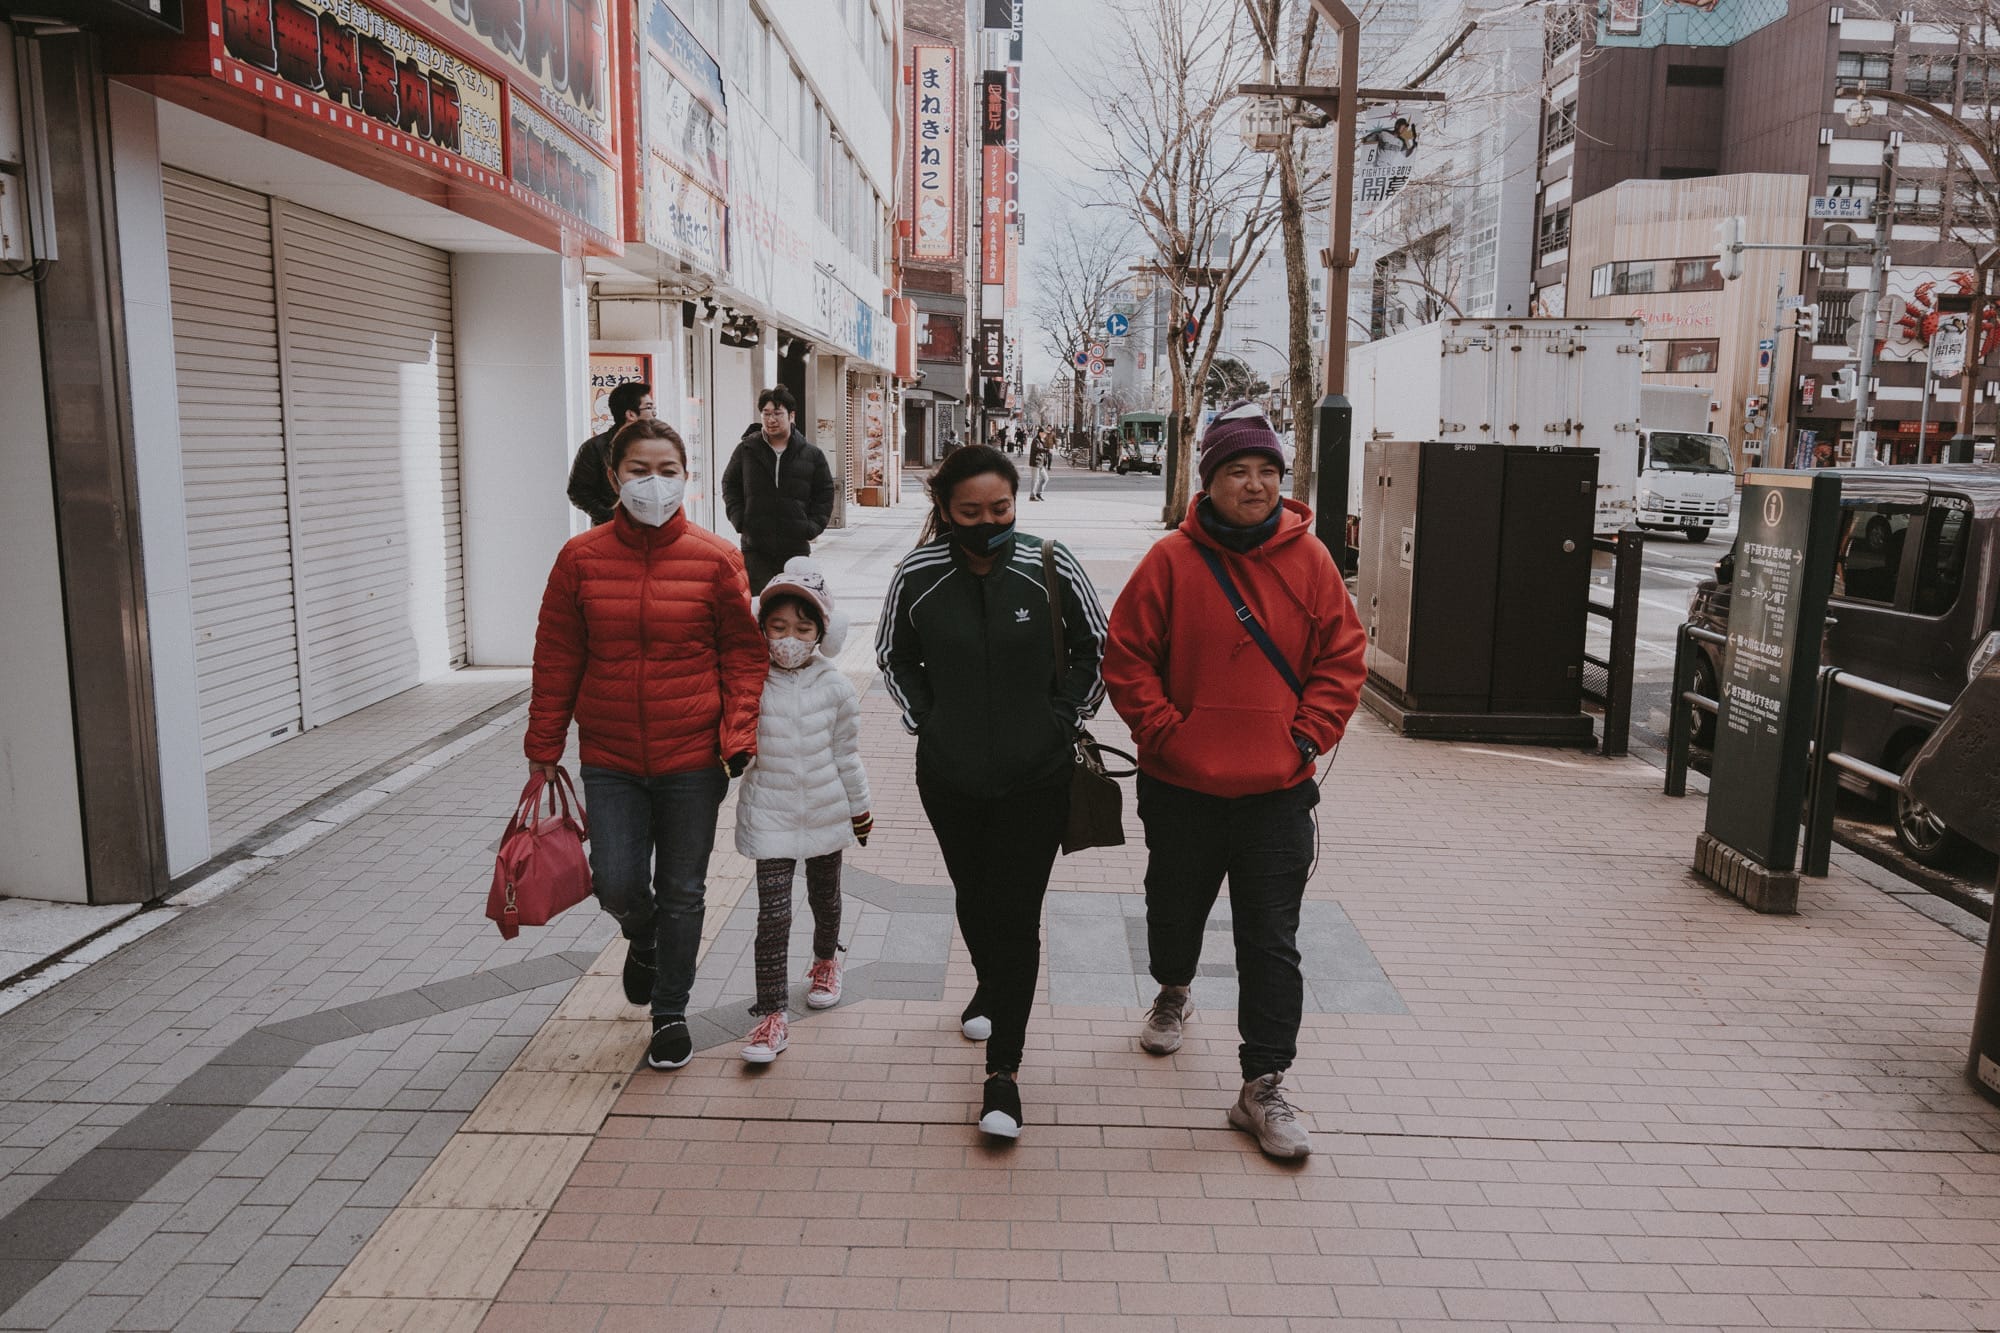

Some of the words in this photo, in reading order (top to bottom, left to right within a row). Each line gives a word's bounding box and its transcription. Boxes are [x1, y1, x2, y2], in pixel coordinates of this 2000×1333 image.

[463, 103, 499, 140] すすきの
[921, 67, 941, 190] まねきねこ
[463, 131, 501, 172] 駅前通店
[1361, 167, 1396, 177] FIGHTERS
[1396, 165, 1412, 176] 2019
[1361, 175, 1409, 201] 開幕
[1815, 198, 1862, 210] 南6西4
[987, 331, 999, 366] ZERO
[1751, 587, 1787, 605] ラーメン横丁
